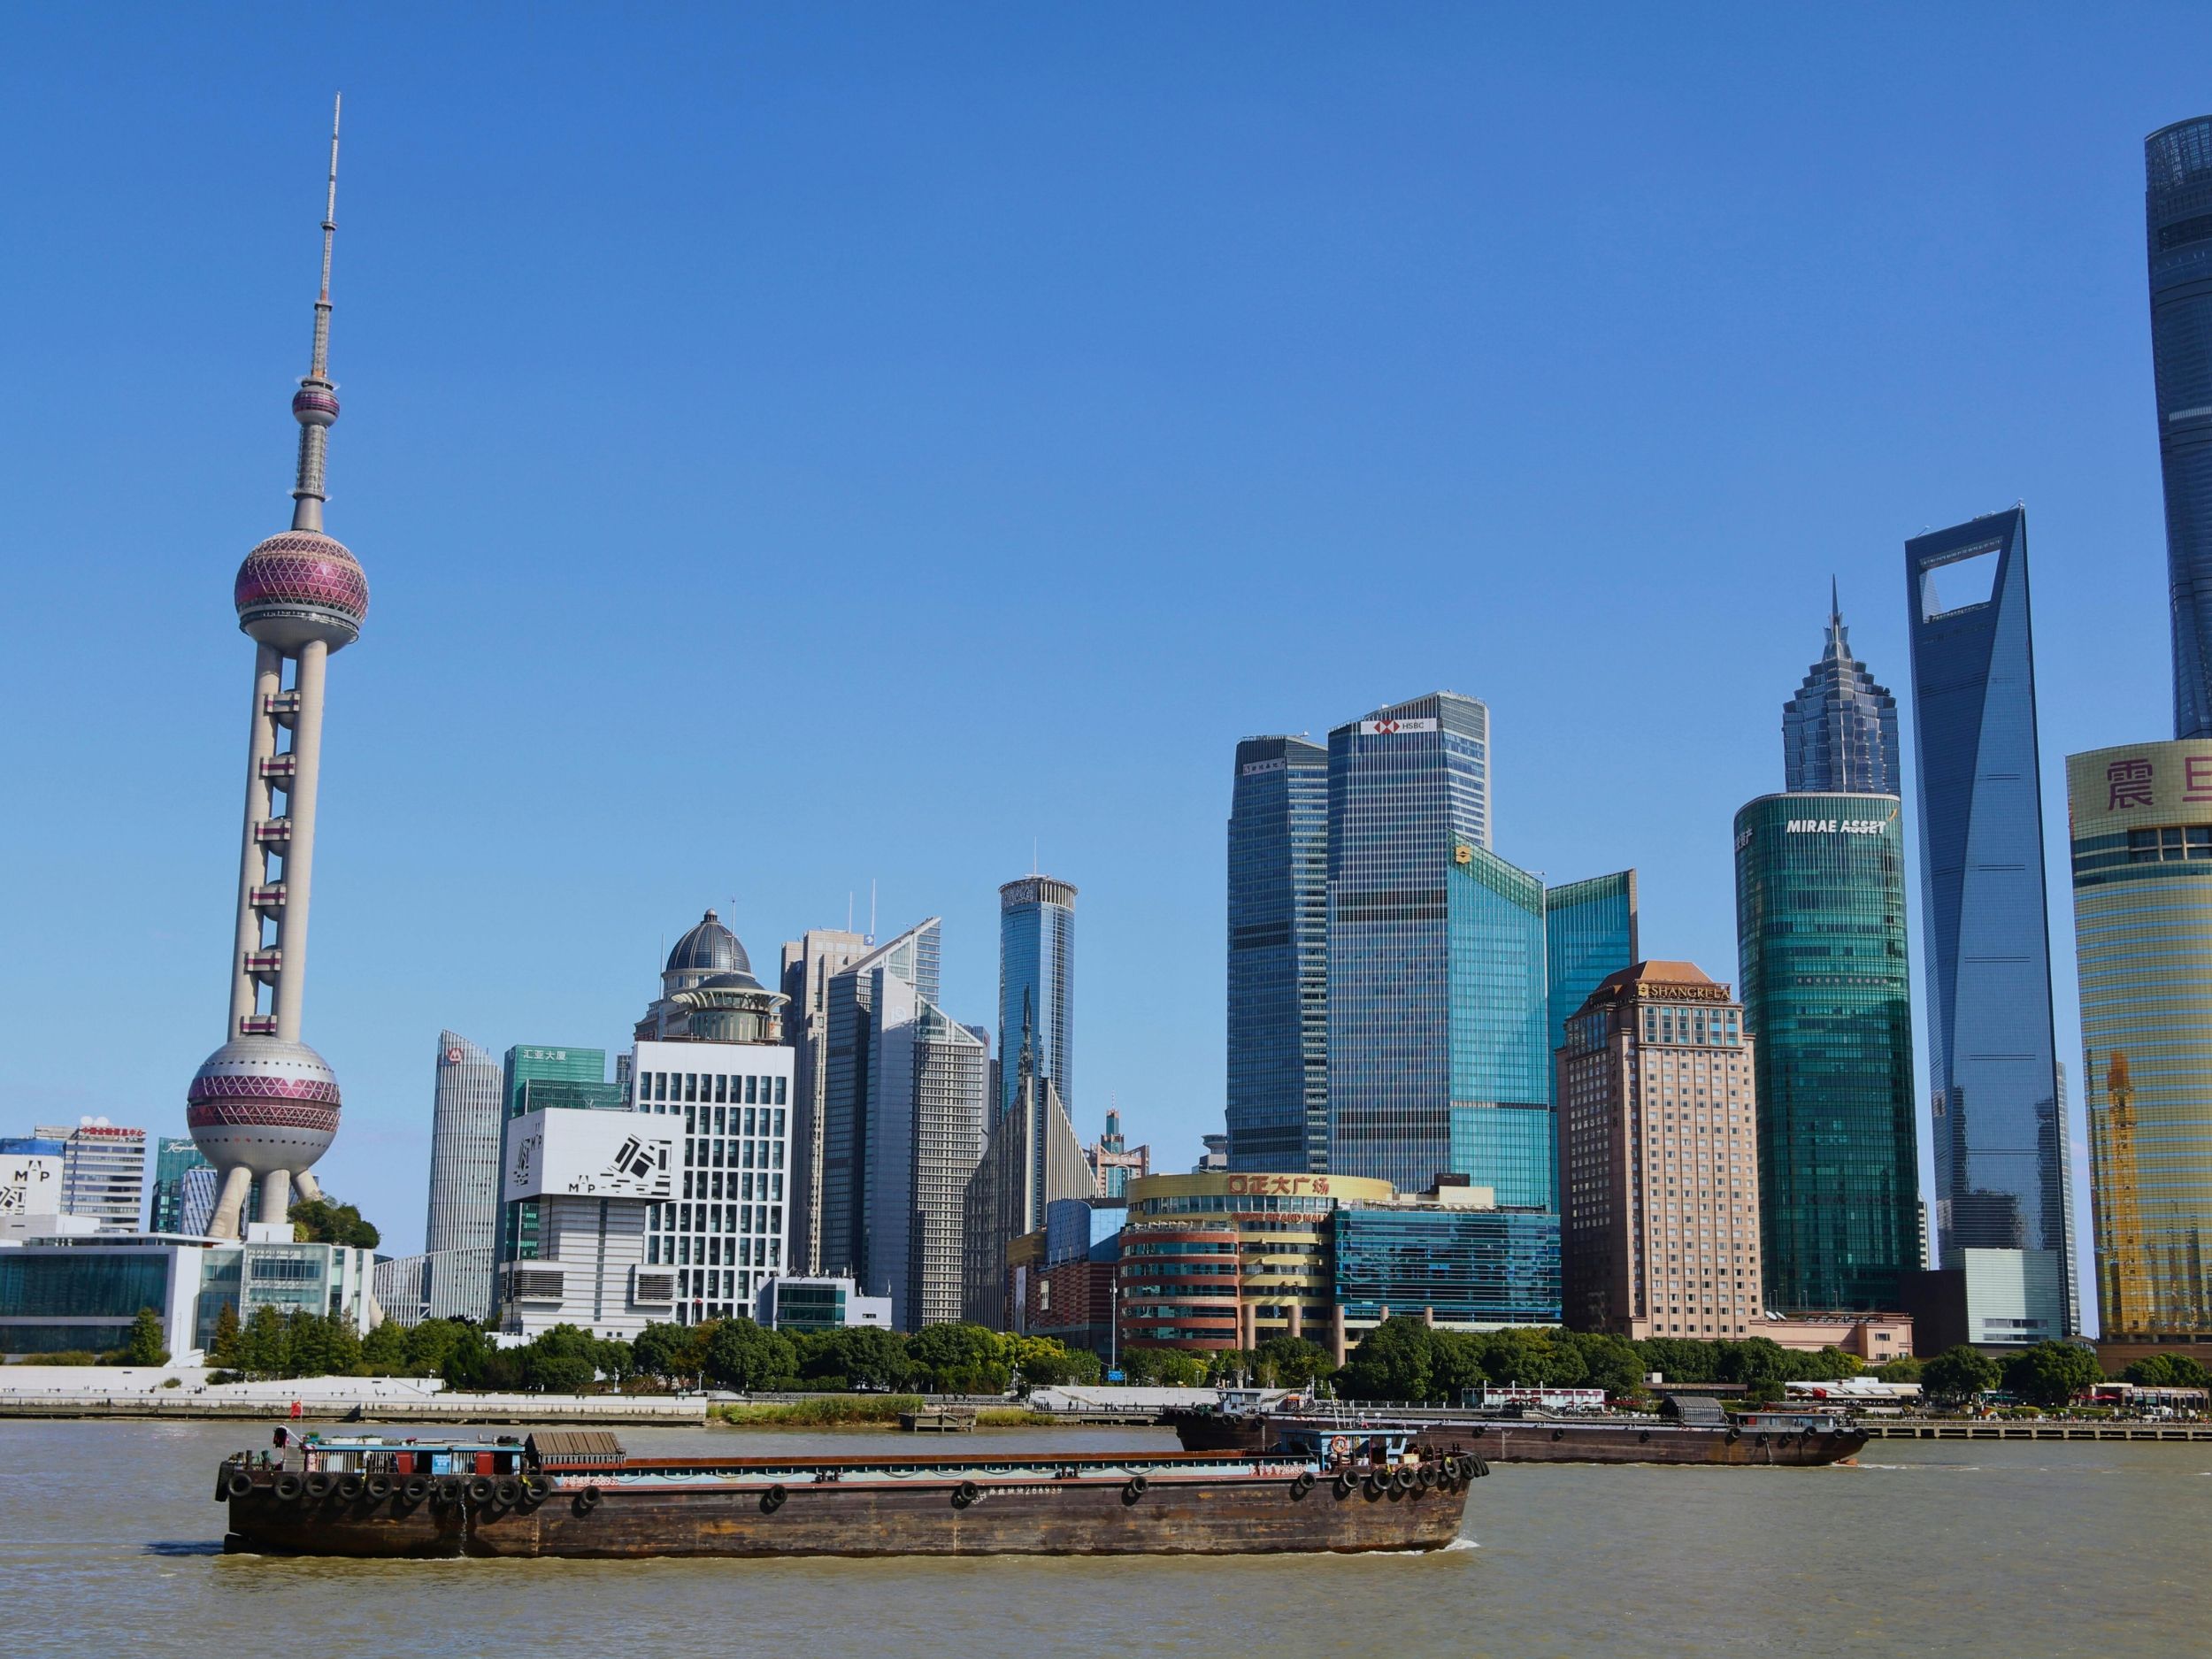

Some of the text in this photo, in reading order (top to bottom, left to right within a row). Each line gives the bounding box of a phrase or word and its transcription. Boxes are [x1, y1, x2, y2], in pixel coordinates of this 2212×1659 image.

[1786, 819, 1887, 834] MIRAE ASSET
[1651, 987, 1731, 999] SHANGRI-LA
[523, 1049, 567, 1061] 汇亚大厦
[14, 1160, 50, 1182] MAP
[568, 1174, 595, 1193] MAP
[1248, 1175, 1330, 1195] 正大广场
[1265, 1212, 1302, 1224] BRAND
